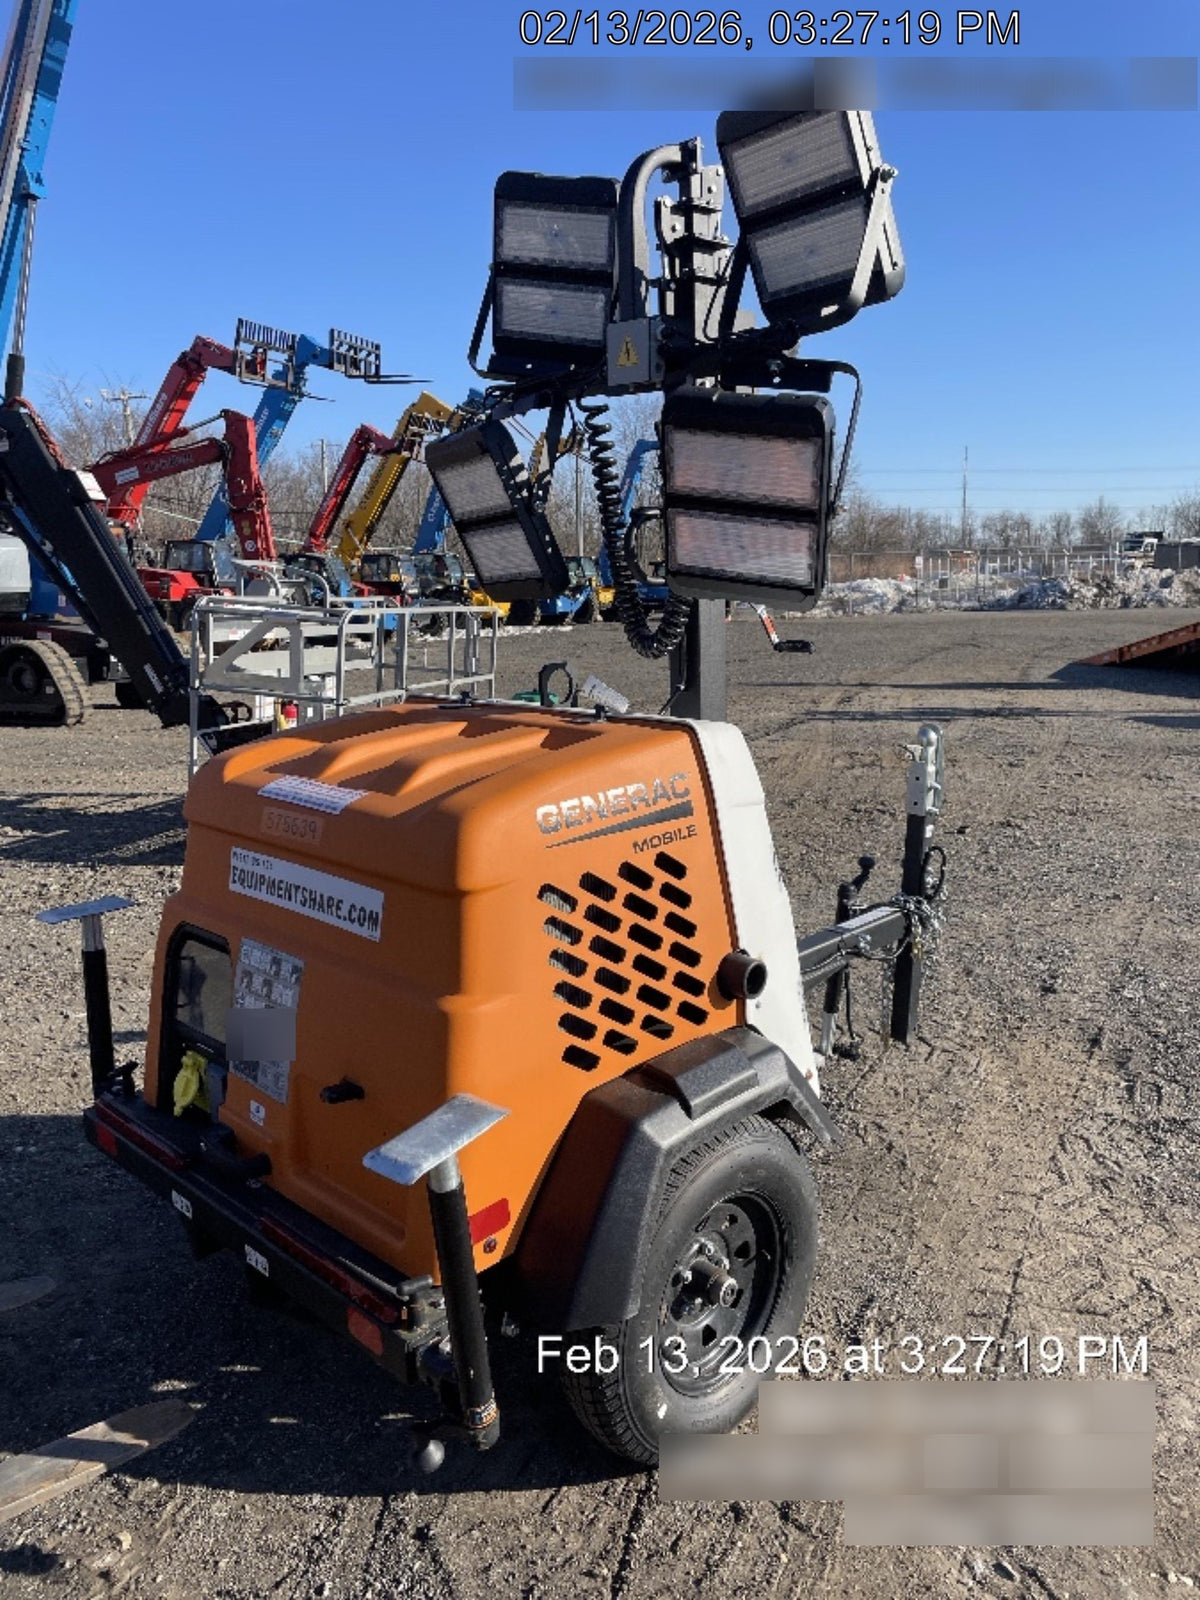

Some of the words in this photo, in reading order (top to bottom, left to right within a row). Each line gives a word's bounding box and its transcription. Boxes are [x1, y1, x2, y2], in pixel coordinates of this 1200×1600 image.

[535, 773, 691, 835] GENERAC
[632, 824, 698, 854] MOBILE
[231, 865, 381, 933] EQUIPMENTSHARE.COM
